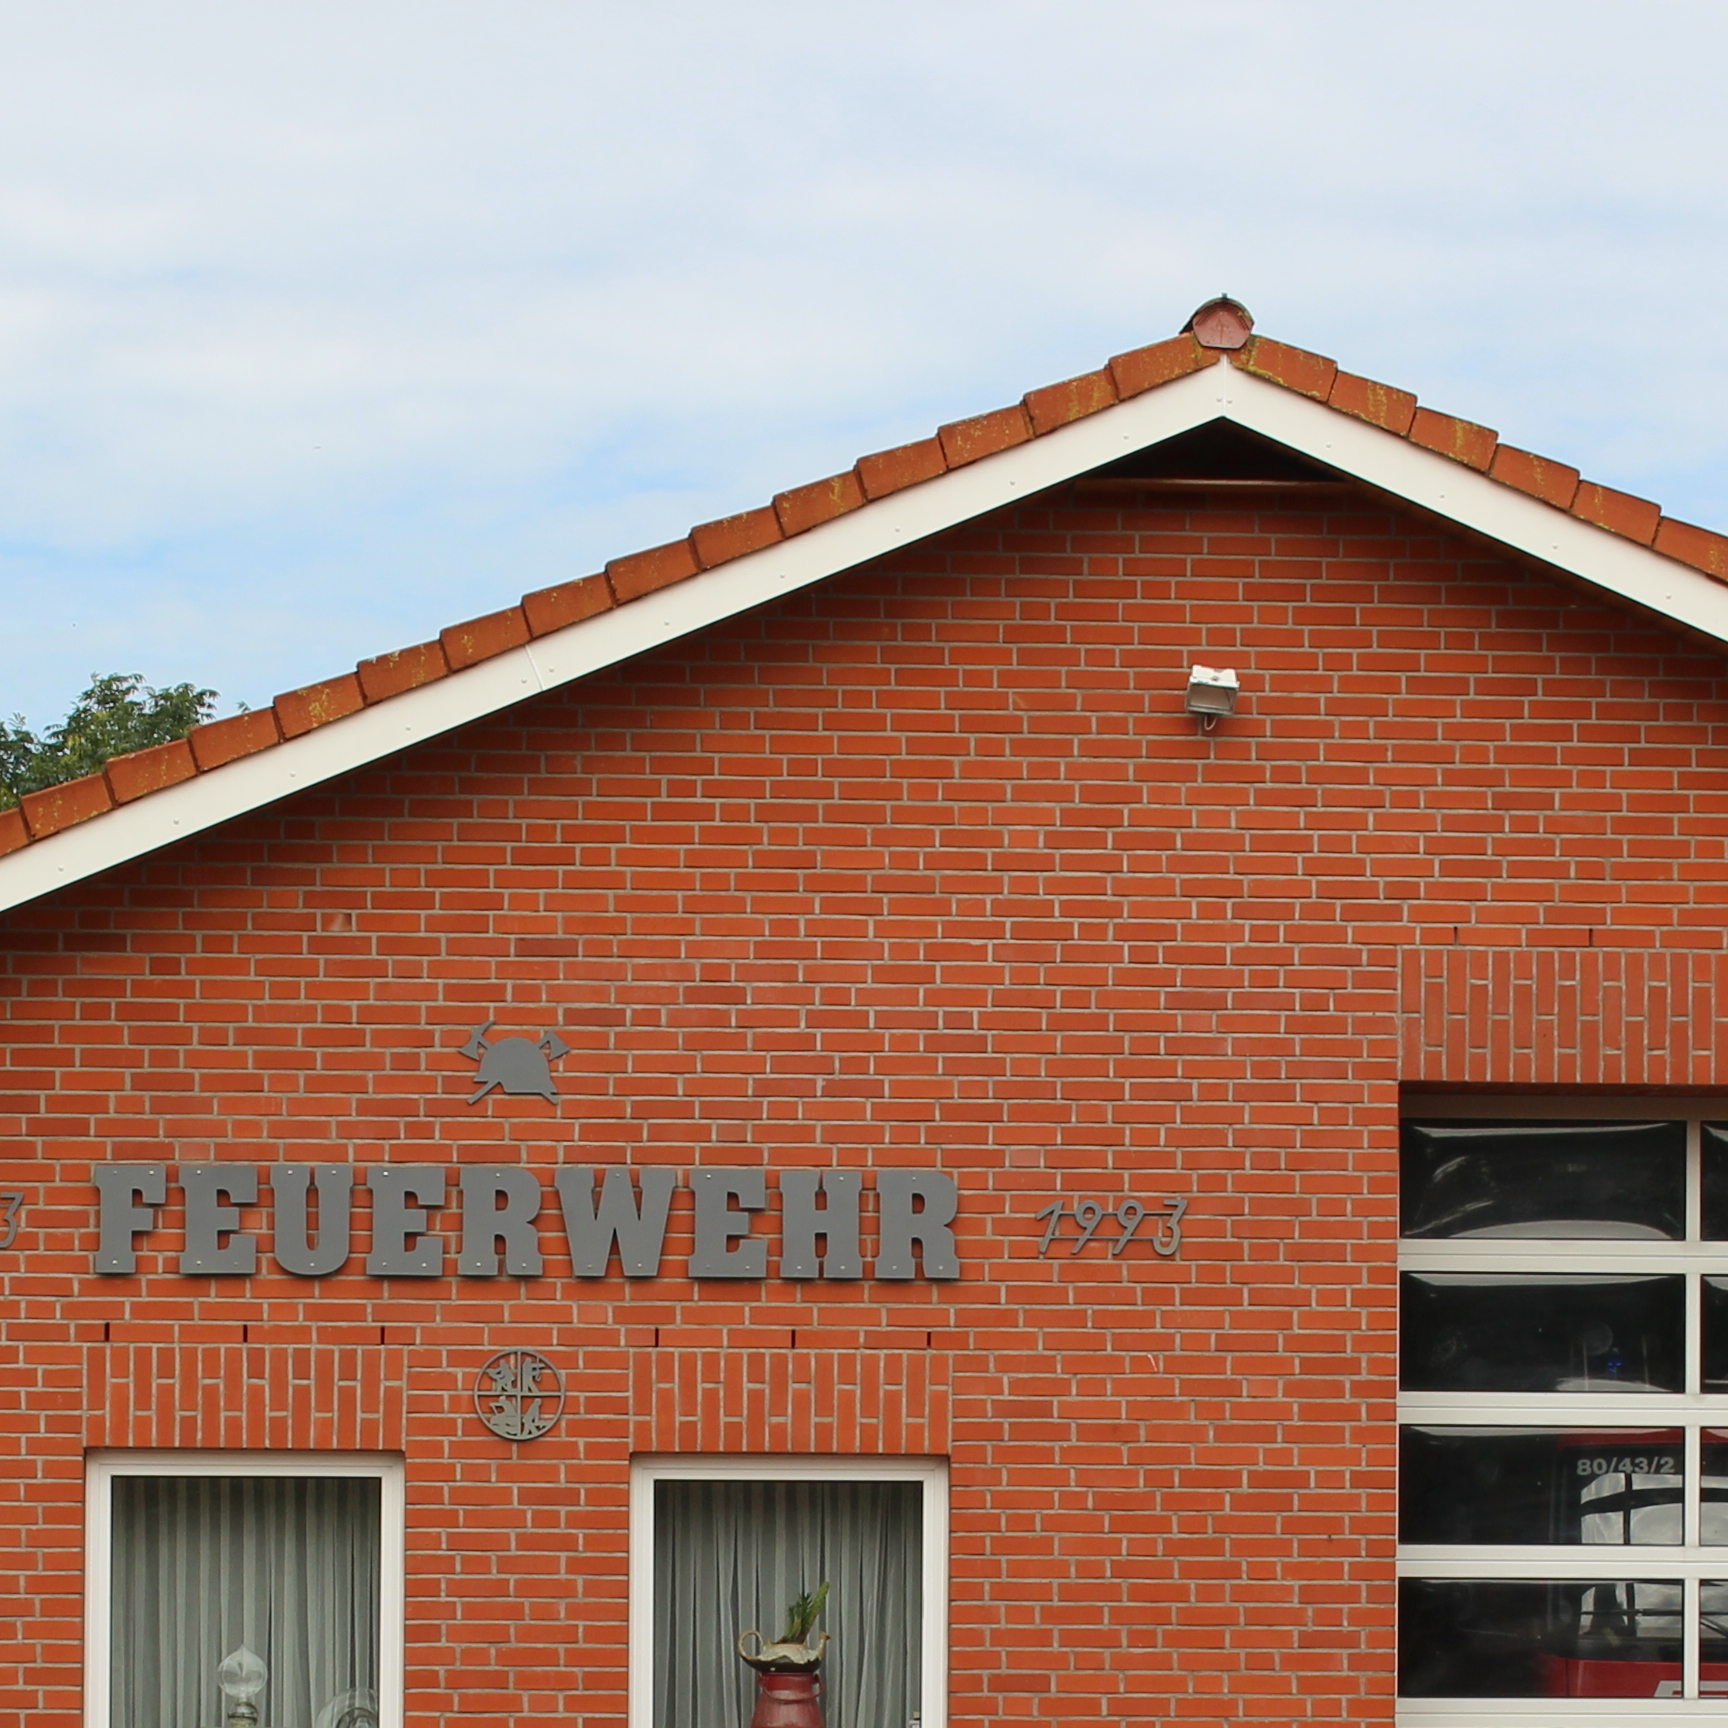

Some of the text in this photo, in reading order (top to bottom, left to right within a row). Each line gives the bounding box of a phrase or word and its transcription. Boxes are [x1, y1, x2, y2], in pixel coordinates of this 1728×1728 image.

[94, 1164, 960, 1277] FEUERWEHR
[1036, 1199, 1189, 1256] 1993
[1576, 1456, 1675, 1476] 80/43/2
